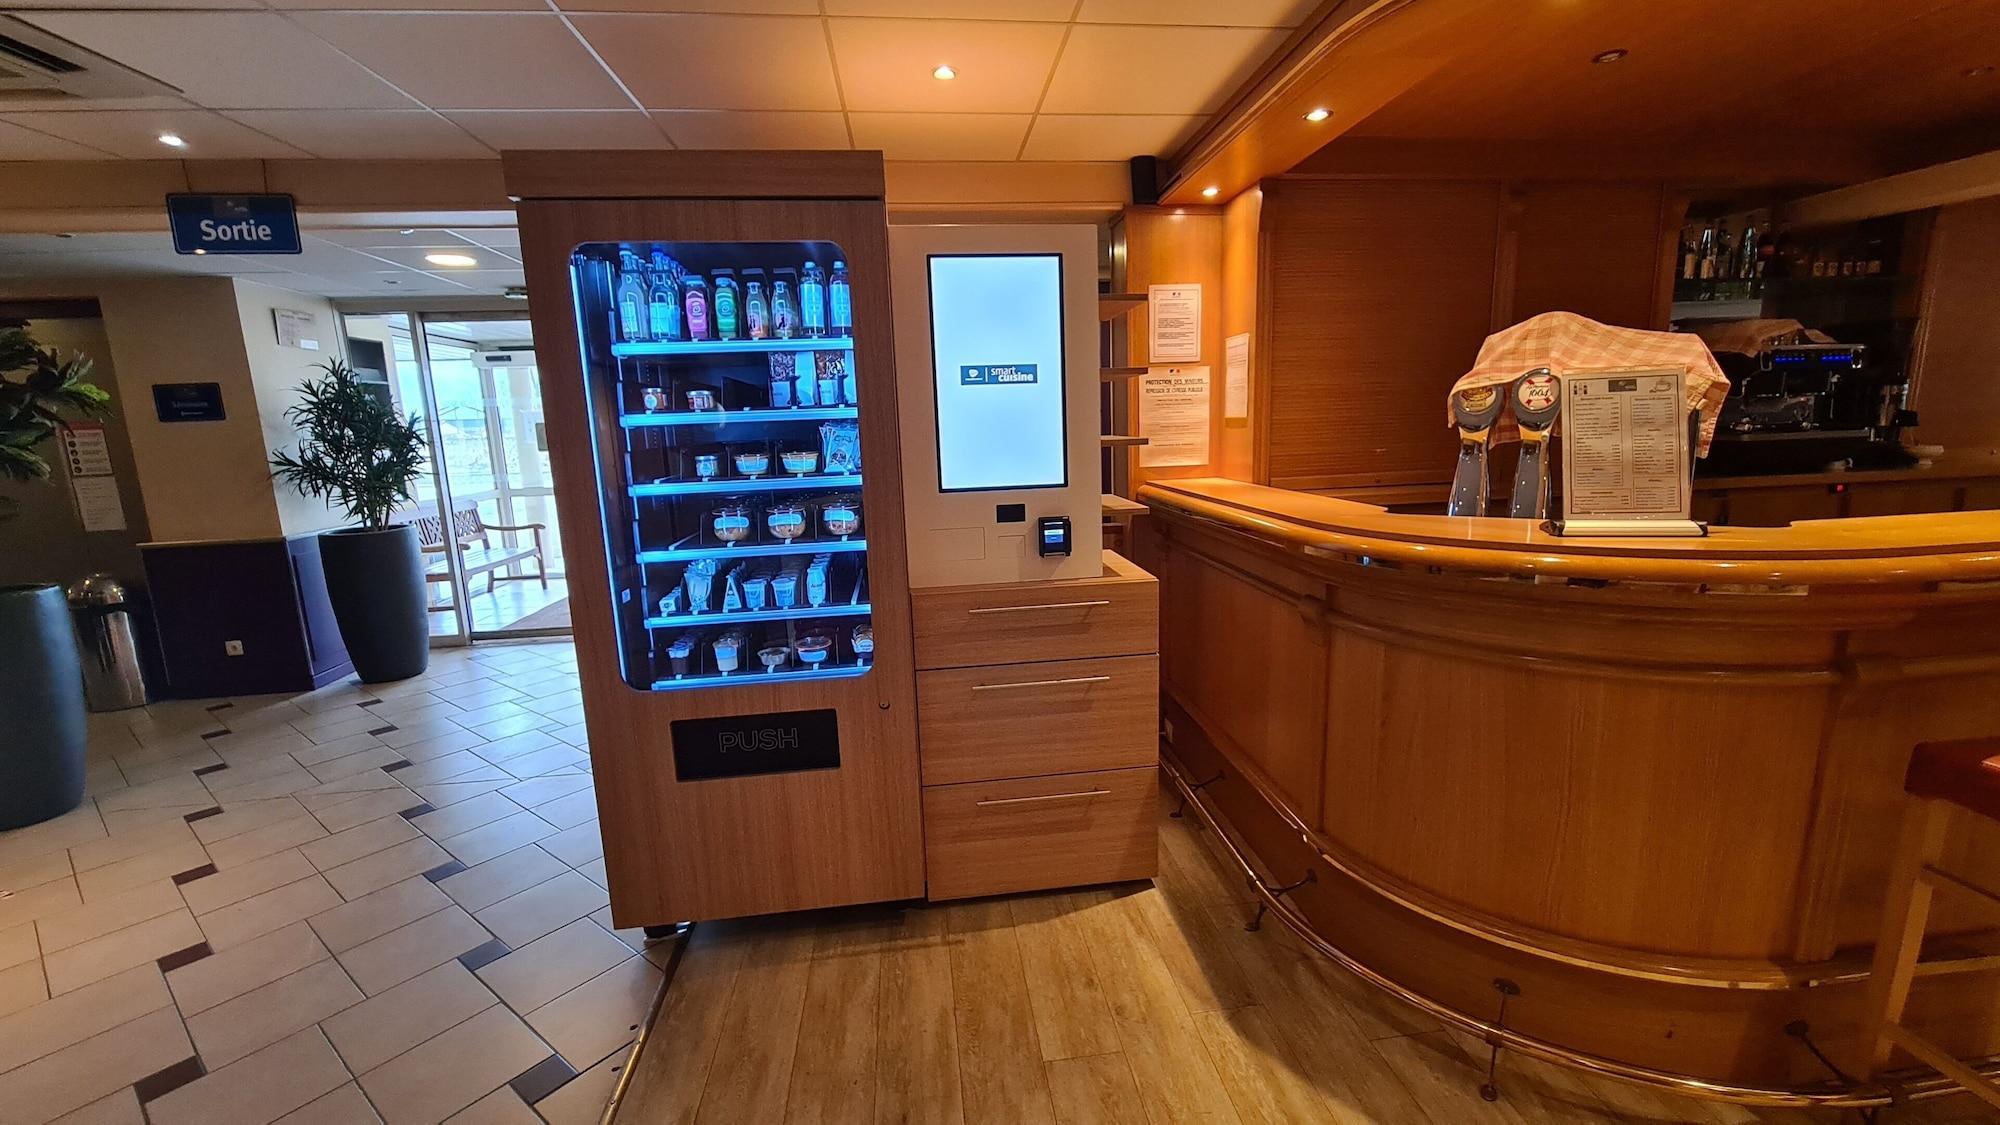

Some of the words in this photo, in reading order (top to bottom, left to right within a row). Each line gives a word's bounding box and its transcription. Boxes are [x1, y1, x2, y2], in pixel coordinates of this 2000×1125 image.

[200, 219, 272, 241] Sortie
[990, 366, 1016, 376] smart
[998, 372, 1034, 382] cuisine
[718, 728, 799, 753] PUSH
